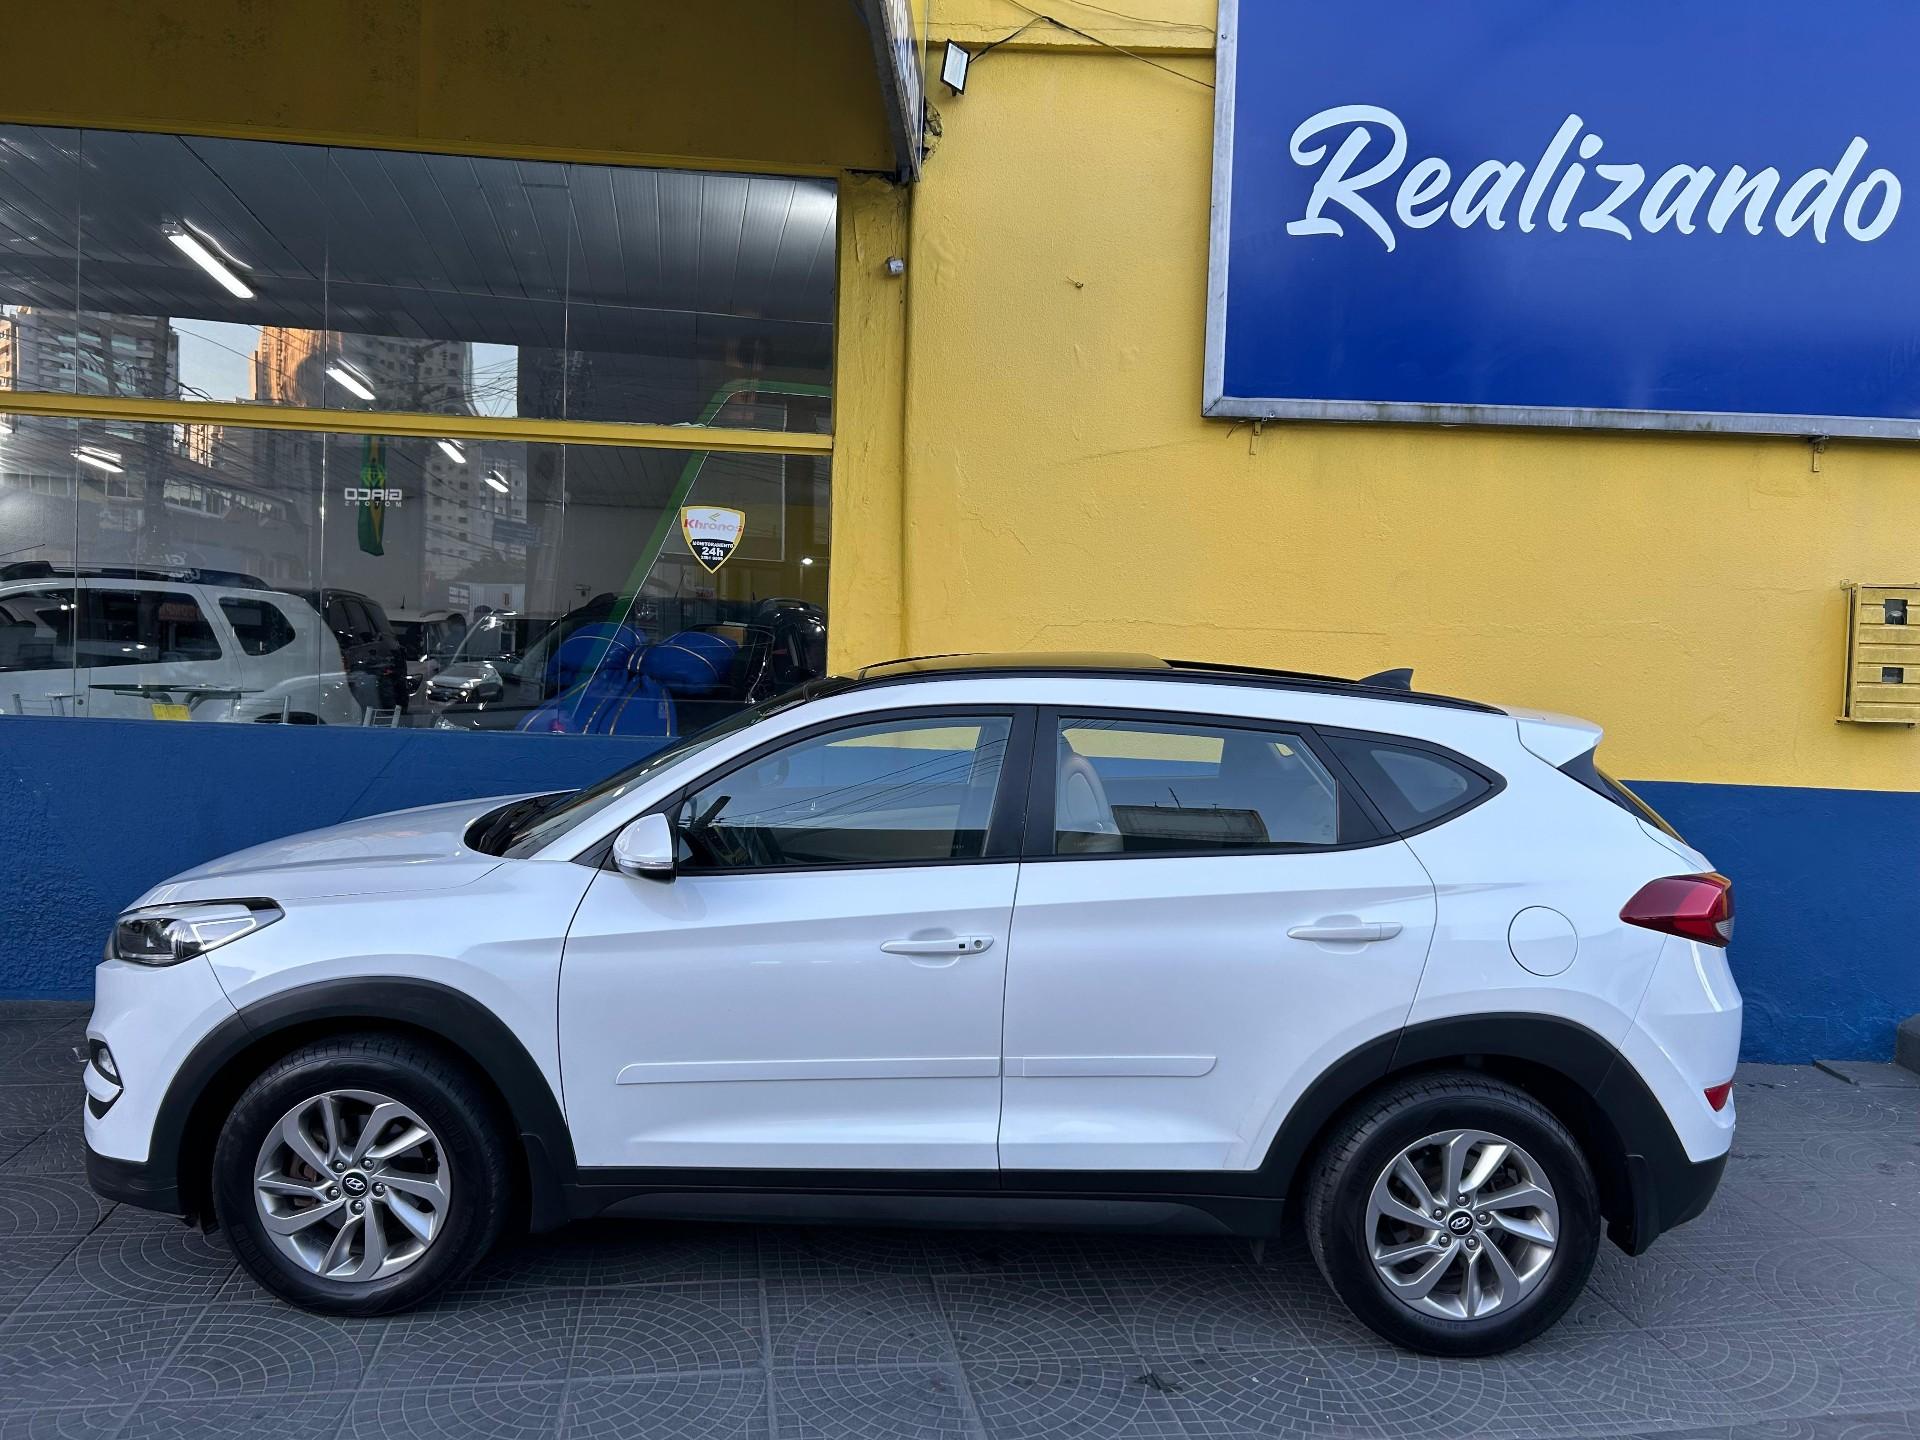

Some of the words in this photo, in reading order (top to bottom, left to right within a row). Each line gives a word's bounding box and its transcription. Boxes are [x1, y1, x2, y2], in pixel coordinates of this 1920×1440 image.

[1286, 104, 1902, 253] Realizando
[684, 519, 742, 532] Khronos
[702, 547, 724, 556] 24h
